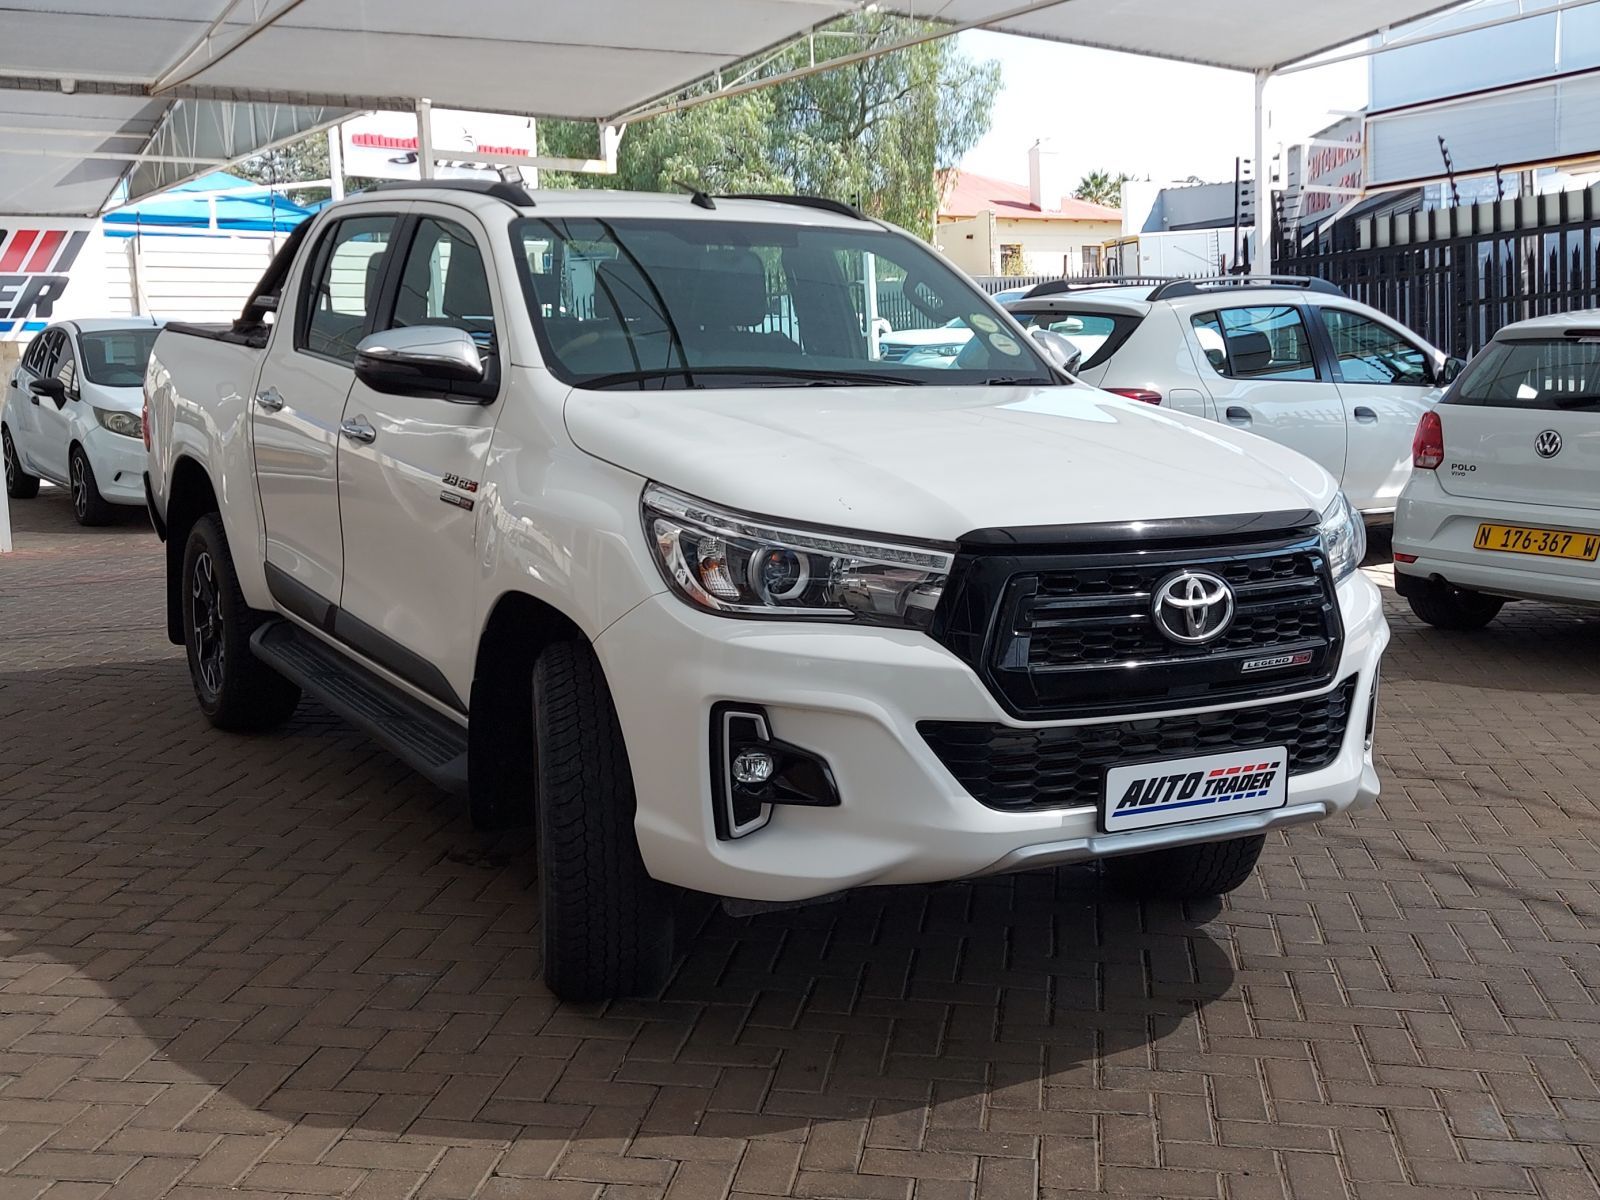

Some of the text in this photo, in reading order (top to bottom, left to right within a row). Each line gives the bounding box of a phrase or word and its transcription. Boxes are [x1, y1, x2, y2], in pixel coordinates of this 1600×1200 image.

[1451, 463, 1477, 472] POLO
[1478, 527, 1597, 557] N 176-367 W
[1247, 657, 1290, 668] LEGEND
[1116, 770, 1276, 809] AUTO TRADER
